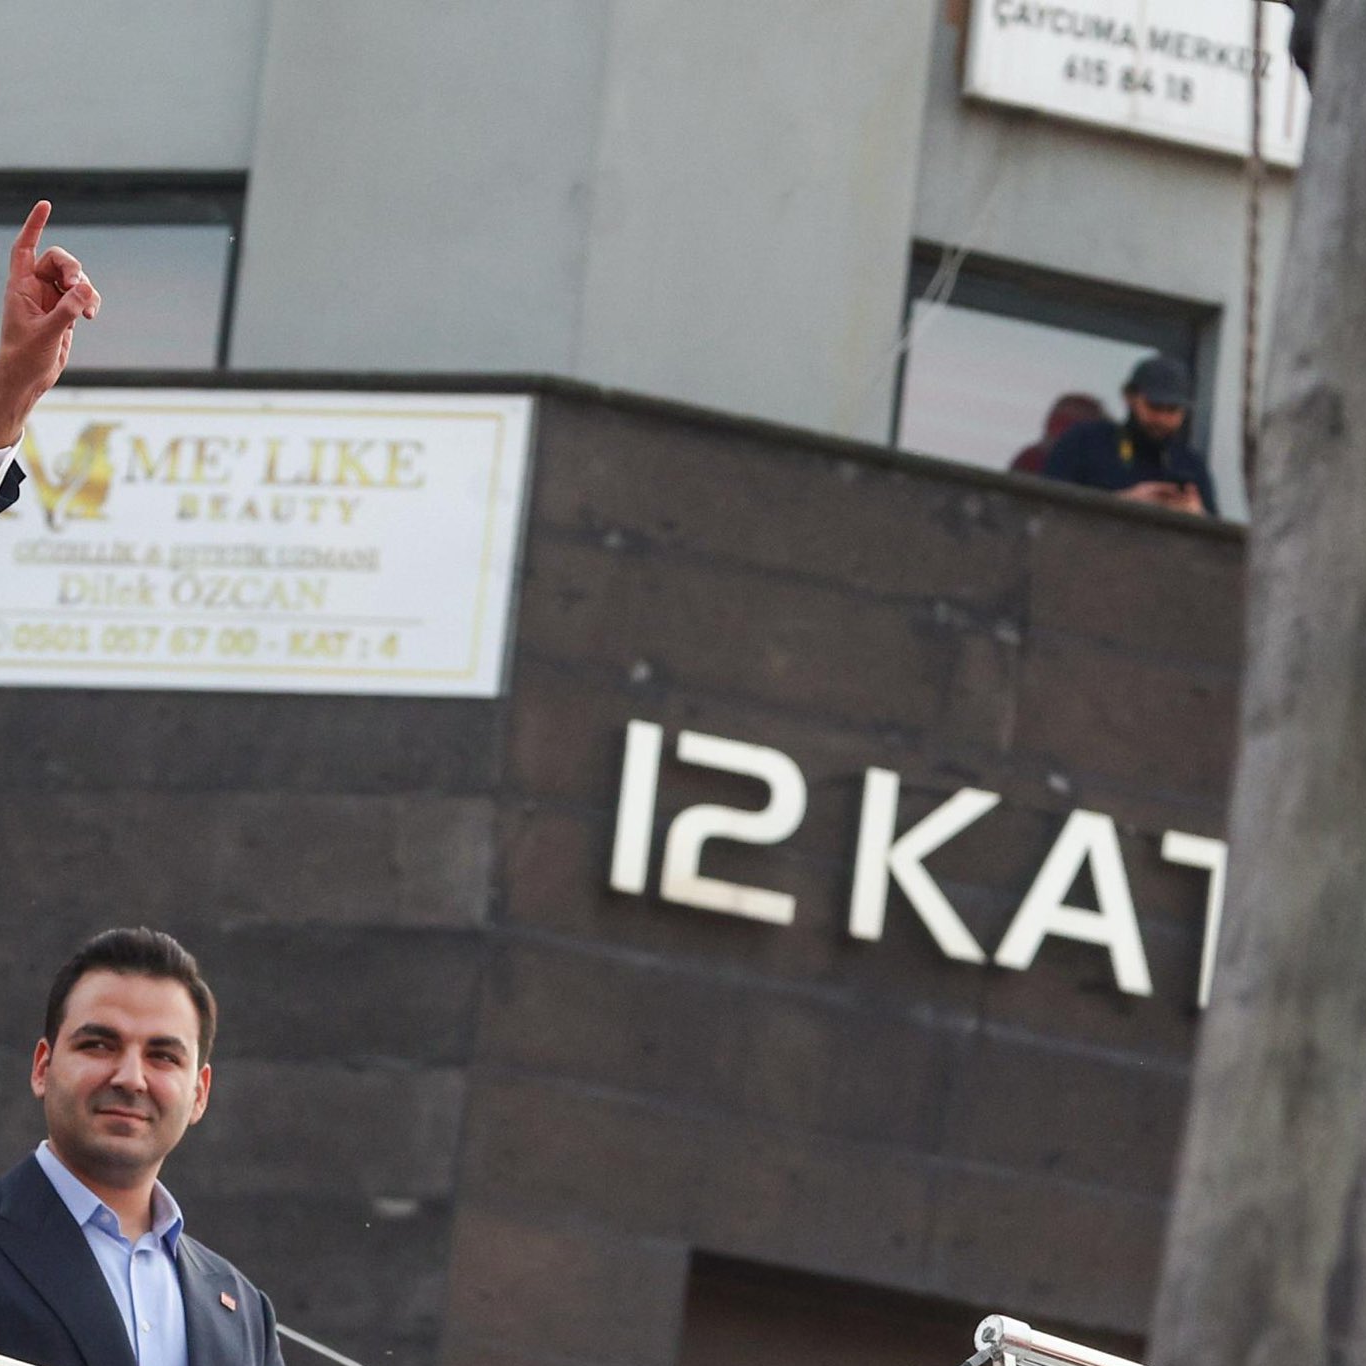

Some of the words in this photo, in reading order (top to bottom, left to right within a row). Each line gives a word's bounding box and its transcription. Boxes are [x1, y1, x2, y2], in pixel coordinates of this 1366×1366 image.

[992, 0, 1139, 50] ÇAYCUMA
[1063, 53, 1108, 87] 615
[1165, 72, 1195, 102] 18
[261, 436, 426, 490] LIKE
[176, 493, 361, 524] BEAUTY
[57, 573, 155, 606] Dilek
[170, 570, 329, 609] ÖZCAN
[288, 629, 352, 659] KAT
[378, 630, 401, 660] 4
[610, 718, 808, 926] 12
